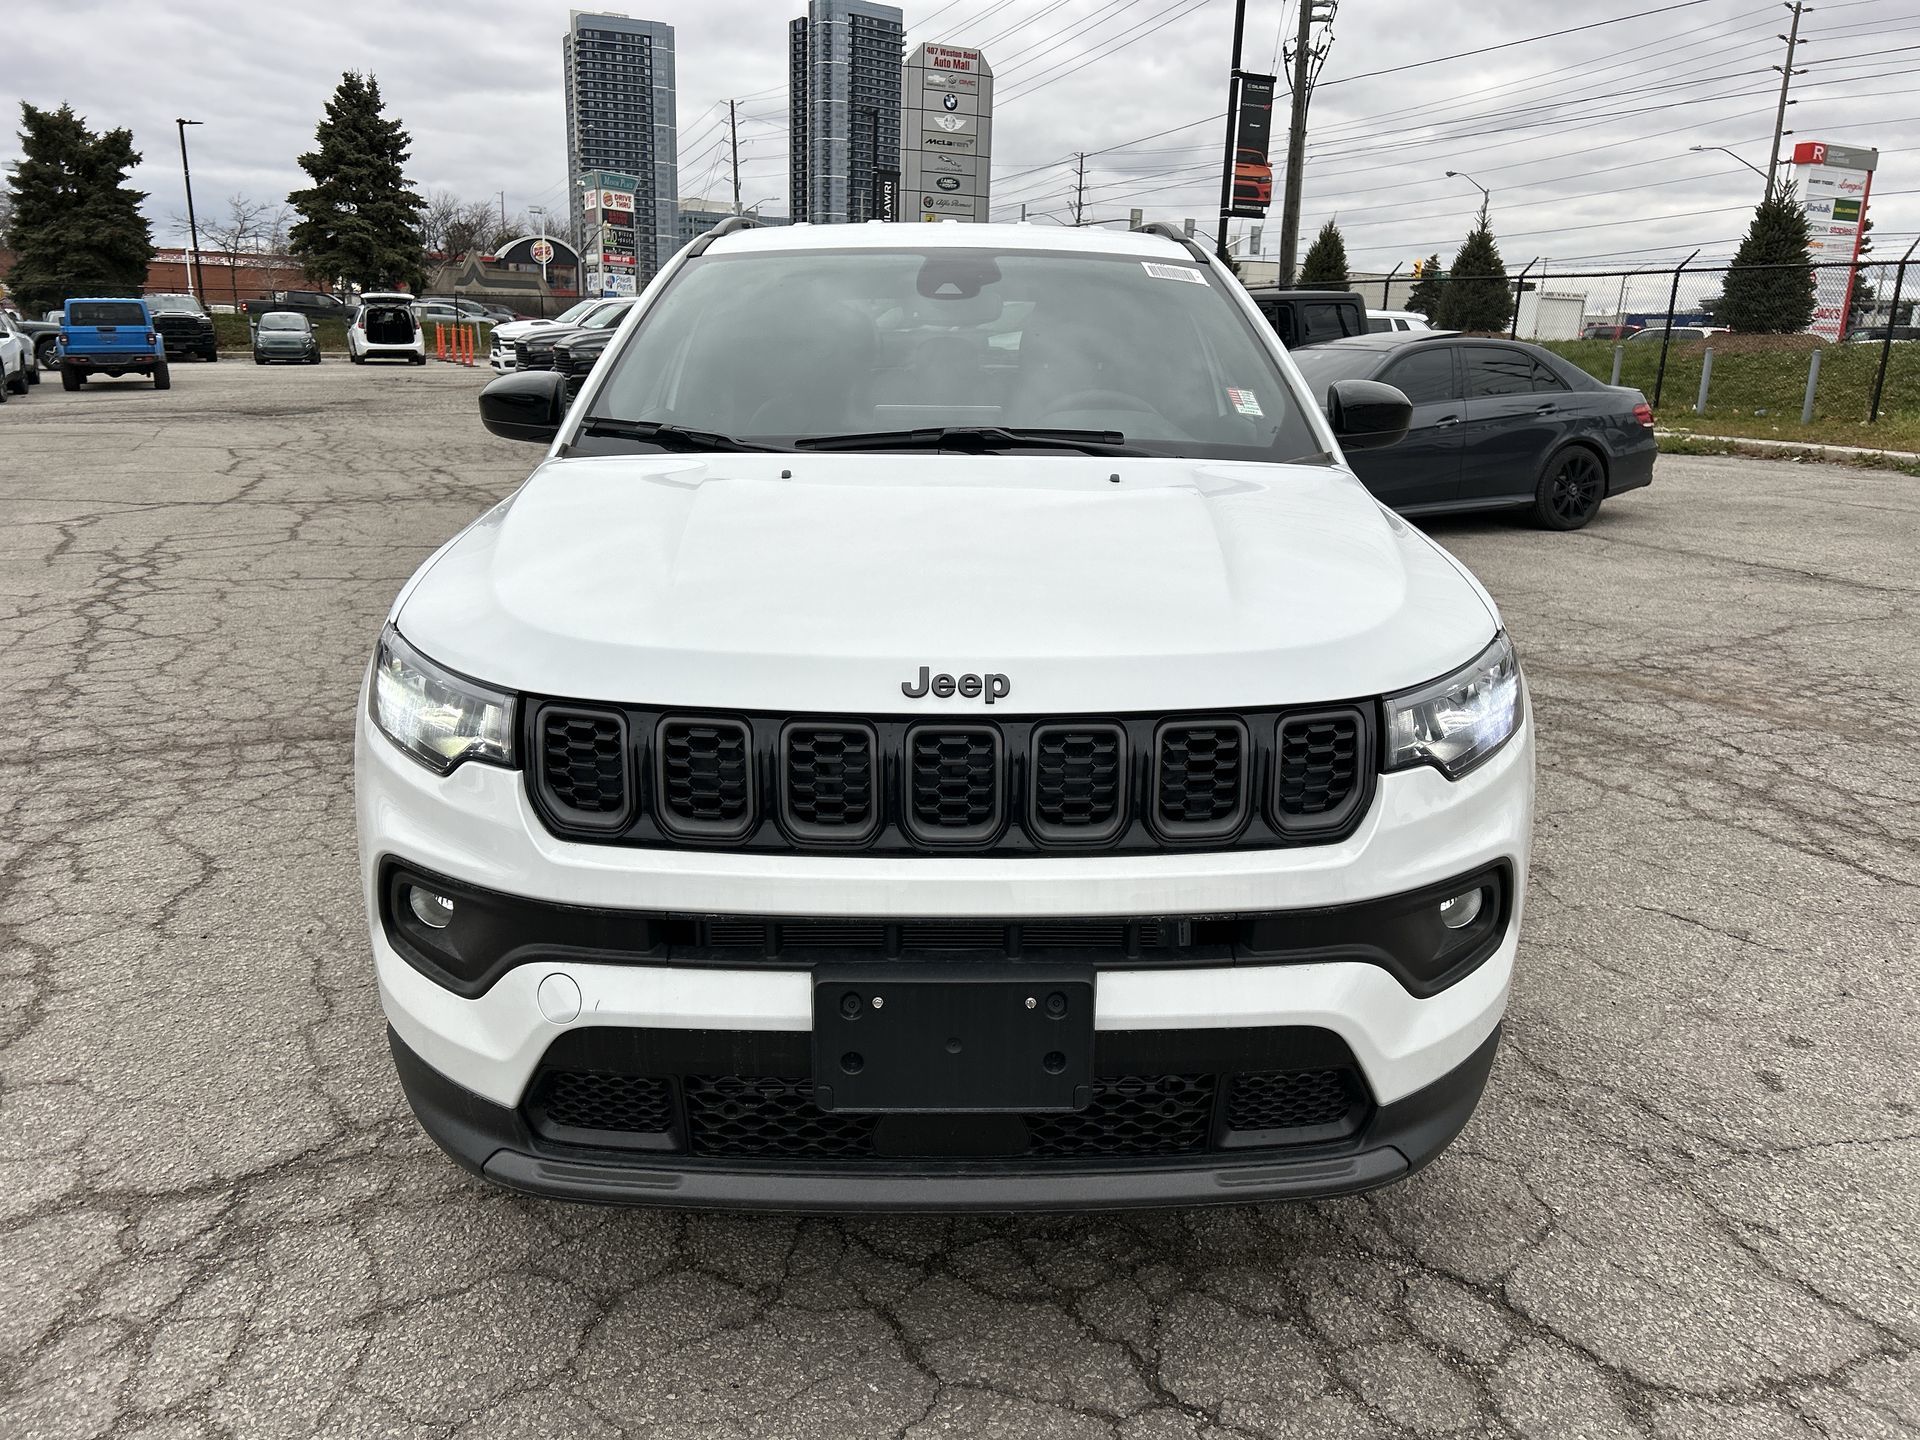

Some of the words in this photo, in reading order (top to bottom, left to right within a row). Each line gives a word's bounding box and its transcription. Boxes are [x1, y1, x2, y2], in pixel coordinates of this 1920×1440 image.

[927, 46, 938, 55] 407
[940, 48, 962, 58] Weston
[963, 51, 977, 60] Road
[934, 56, 951, 68] Auto
[953, 59, 970, 71] Mall
[925, 139, 969, 148] McLaren
[1813, 145, 1825, 160] R
[614, 194, 632, 202] DRIVE
[616, 201, 631, 209] THRU
[884, 181, 892, 222] ILAWRI
[901, 666, 1011, 705] Jeep
